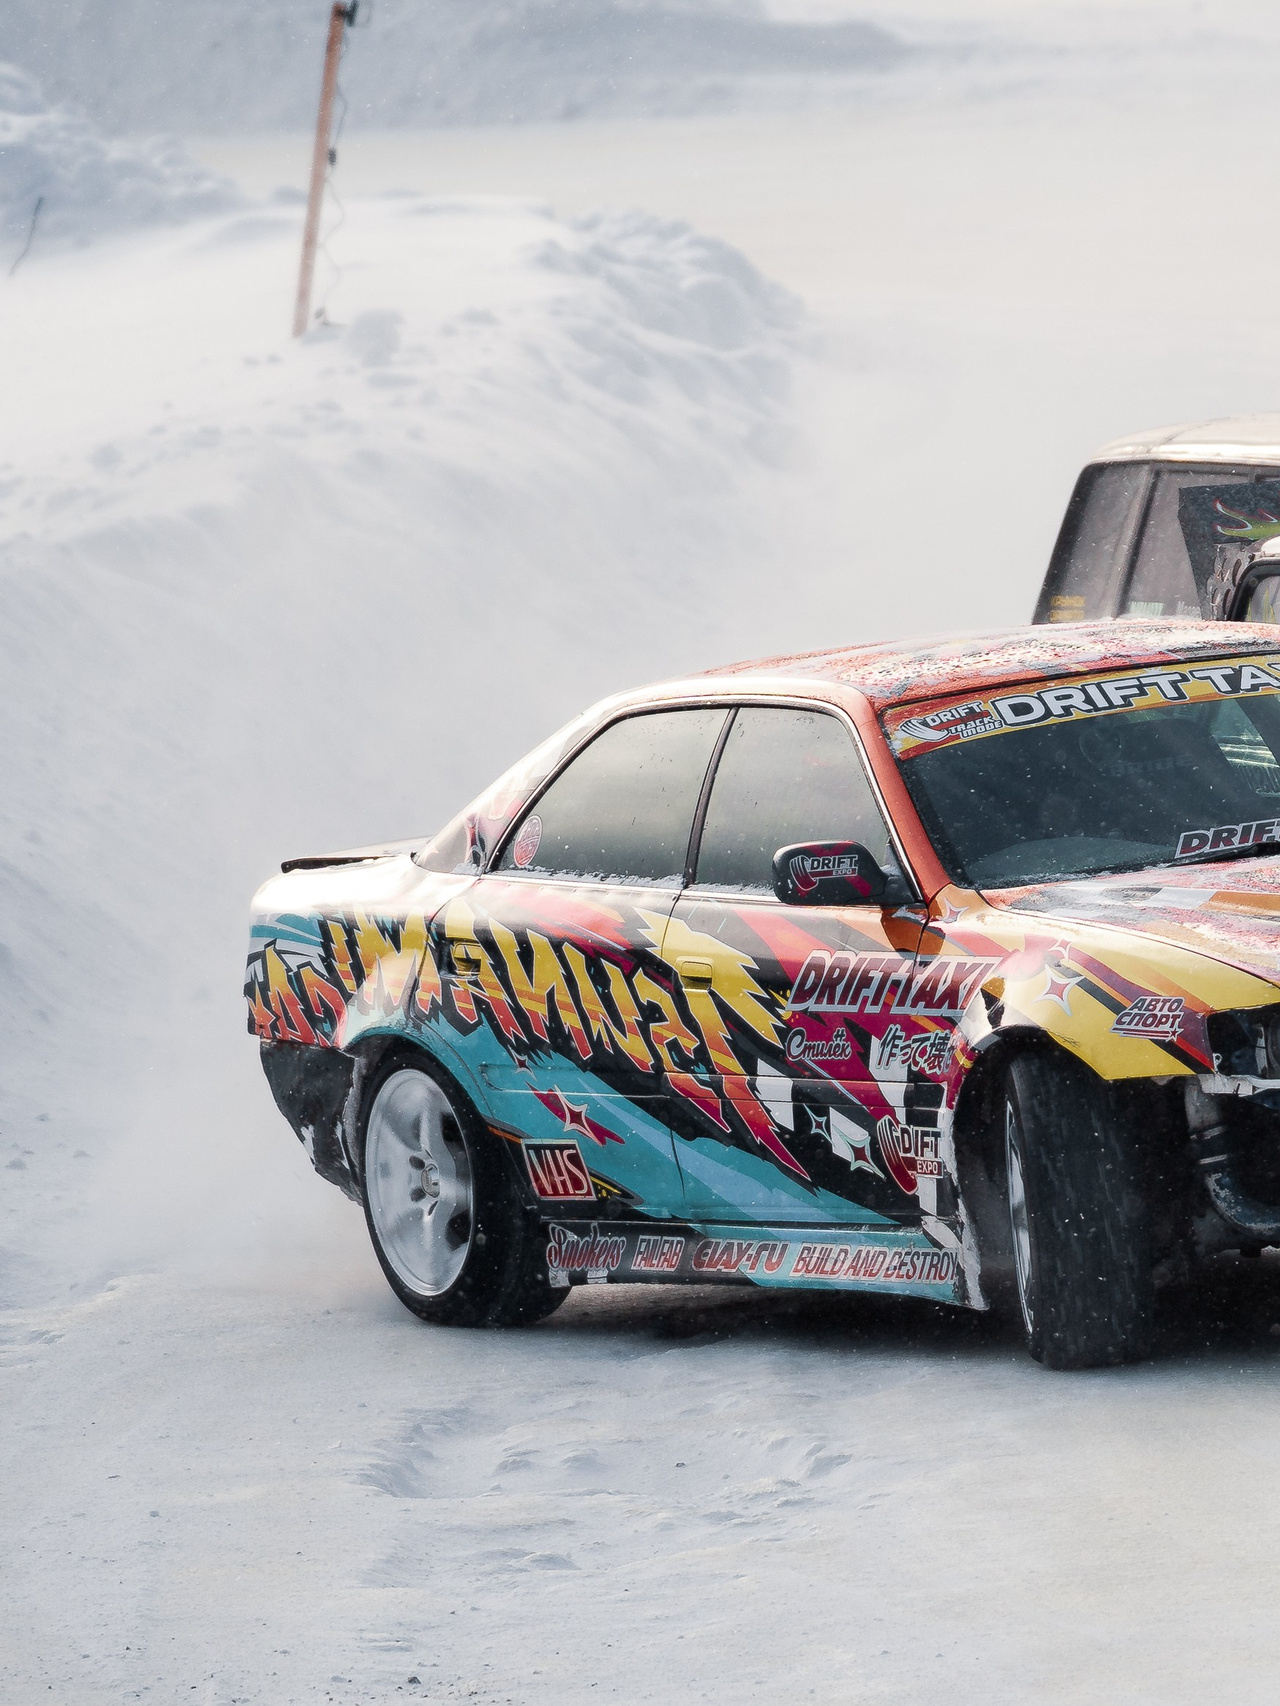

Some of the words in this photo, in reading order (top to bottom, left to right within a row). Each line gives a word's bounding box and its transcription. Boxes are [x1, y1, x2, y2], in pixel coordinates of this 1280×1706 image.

[994, 672, 1185, 726] DRIFT
[924, 701, 982, 727] DRIFT
[810, 856, 858, 870] DRIFT
[832, 868, 854, 876] EXPO
[790, 955, 902, 1009] DRIFT
[898, 960, 996, 1010] TAXI
[1127, 997, 1185, 1013] АВТО
[1115, 1011, 1182, 1029] СПОРТ
[900, 1126, 942, 1159] DIFT
[528, 1149, 588, 1194] VHS
[916, 1160, 939, 1174] EXPO
[547, 1223, 626, 1271] Smokers
[793, 1245, 849, 1276] BUILD
[847, 1248, 885, 1278] AND
[883, 1249, 958, 1281] DESTROY
